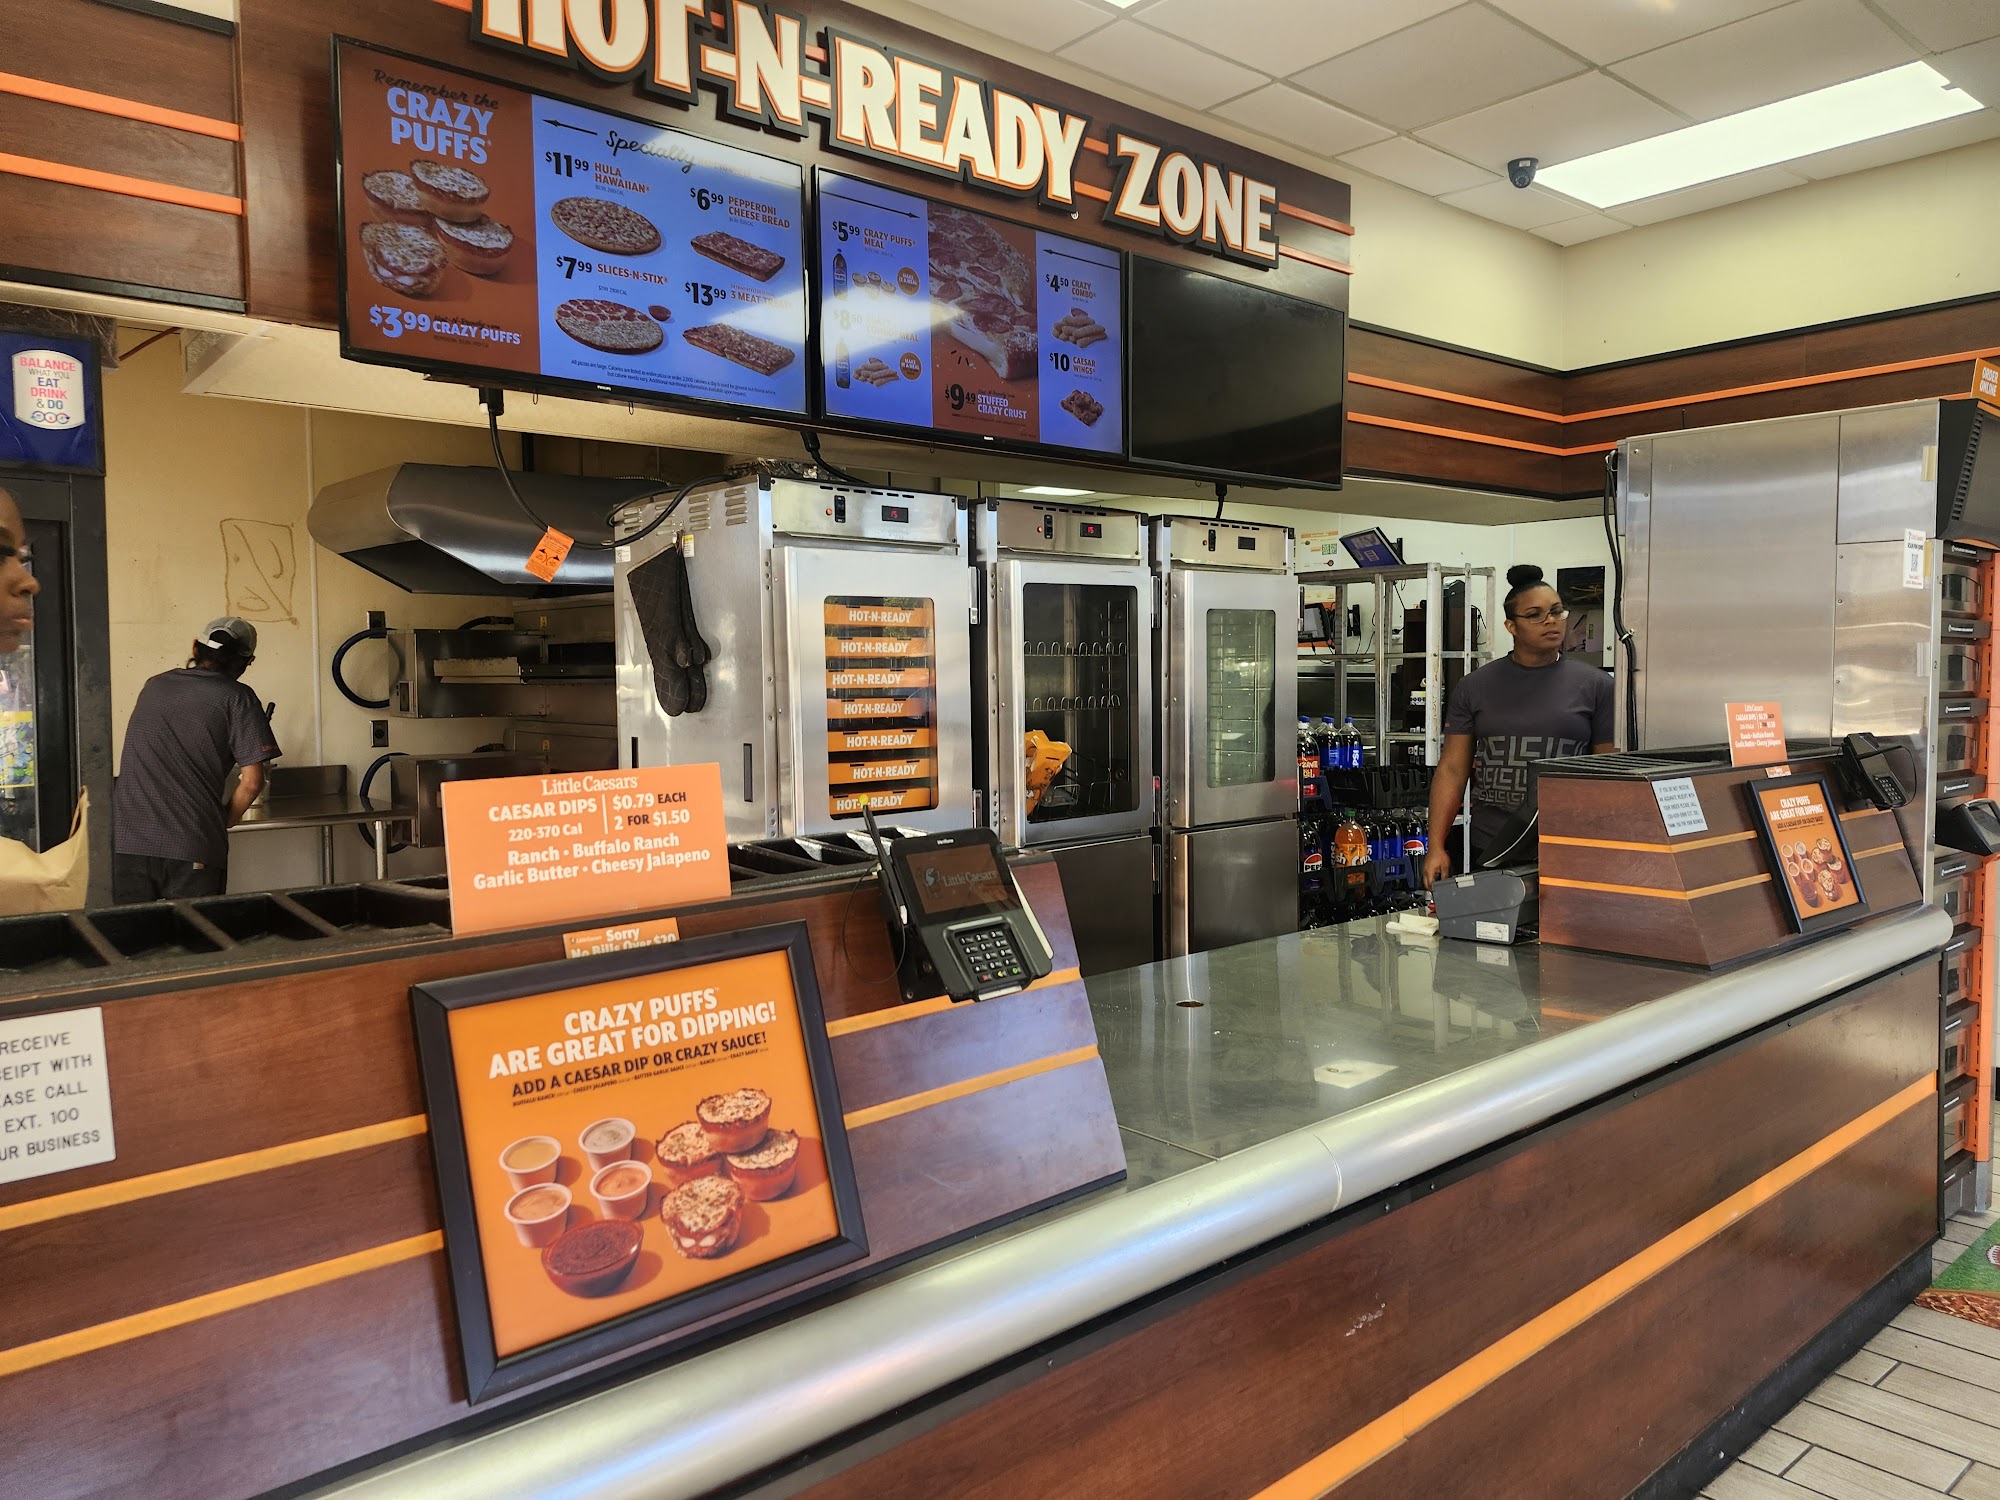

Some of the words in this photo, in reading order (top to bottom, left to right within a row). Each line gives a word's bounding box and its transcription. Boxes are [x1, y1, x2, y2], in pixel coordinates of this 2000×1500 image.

[374, 69, 469, 102] Remember
[474, 93, 499, 109] the
[387, 87, 493, 136] CRAZY
[392, 117, 488, 164] PUFFS
[594, 162, 622, 178] HULA
[728, 196, 776, 216] PEPPERONI
[1114, 133, 1276, 261] ZONE
[728, 206, 760, 222] CHEESE
[762, 214, 790, 228] BREAD
[864, 228, 888, 240] CRAZY
[890, 234, 912, 247] PUFFS
[864, 238, 884, 249] MEAL
[1072, 280, 1091, 290] CRAZY
[730, 291, 736, 299] 3
[738, 292, 760, 304] MEAT
[433, 320, 478, 338] CRAZY
[481, 328, 520, 344] PUFFS
[20, 357, 76, 371] BALANCE
[1050, 352, 1070, 372] $10
[1073, 356, 1096, 368] CAESAR
[28, 368, 50, 376] WHAT
[54, 370, 70, 379] YOU
[38, 377, 59, 388] EAT
[30, 388, 68, 400] DRINK
[978, 394, 1008, 407] STUFFED
[36, 398, 44, 408] &
[48, 400, 64, 410] DO
[978, 404, 1002, 416] CRAZY
[1004, 408, 1027, 420] CRUST
[849, 610, 911, 623] HOT-N-READY
[841, 642, 908, 653] HOT-N-READY
[832, 674, 901, 685] HOT-N-READY
[844, 703, 903, 714] HOT-N-READY
[846, 735, 913, 747] HOT-N-READY
[1352, 750, 1360, 768] PSI
[853, 765, 916, 780] HOT-N-READY
[541, 778, 581, 796] Little
[582, 776, 638, 792] Caesars
[488, 802, 556, 822] CAESAR
[559, 798, 598, 814] DIPS
[612, 793, 654, 810] $0.79
[658, 792, 686, 804] EACH
[1780, 798, 1796, 808] CRAZY
[1770, 811, 1780, 821] ARE
[1780, 808, 1796, 819] GREAT
[1795, 806, 1806, 816] FOR
[1804, 804, 1824, 815] DIPPING!
[508, 828, 560, 842] 220-370
[563, 823, 582, 836] Cal
[614, 816, 624, 830] 2
[628, 814, 649, 826] FOR
[653, 810, 690, 827] $1.50
[508, 844, 560, 866] Ranch
[573, 836, 631, 858] Buffalo
[634, 833, 680, 850] Ranch
[473, 867, 524, 890] Garlic
[528, 860, 579, 884] Butter
[592, 853, 644, 876] Cheesy
[646, 850, 710, 872] Jalapeno
[942, 874, 966, 887] Little
[966, 870, 997, 882] Caesars
[606, 928, 640, 942] Sorry
[564, 1000, 645, 1036] CRAZY
[649, 988, 718, 1017] PUFFS
[0, 1032, 71, 1055] RECEIVE
[489, 1046, 542, 1080] ARE
[546, 1030, 626, 1066] GREAT
[632, 1021, 678, 1048] FOR
[681, 1001, 777, 1039] DIPPING!
[0, 1062, 41, 1081] EIPT
[51, 1054, 92, 1072] WITH
[512, 1078, 546, 1098] ADD
[550, 1075, 561, 1088] A
[565, 1062, 621, 1086] CAESAR
[624, 1057, 648, 1075] DIP
[653, 1052, 672, 1067] OR
[676, 1041, 718, 1062] CRAZY
[722, 1032, 766, 1052] SAUCE!
[3, 1088, 36, 1107] ASE
[45, 1081, 88, 1098] CALL
[5, 1114, 42, 1132] EXT.
[51, 1107, 80, 1124] 100
[27, 1129, 100, 1156] BUSINESS
